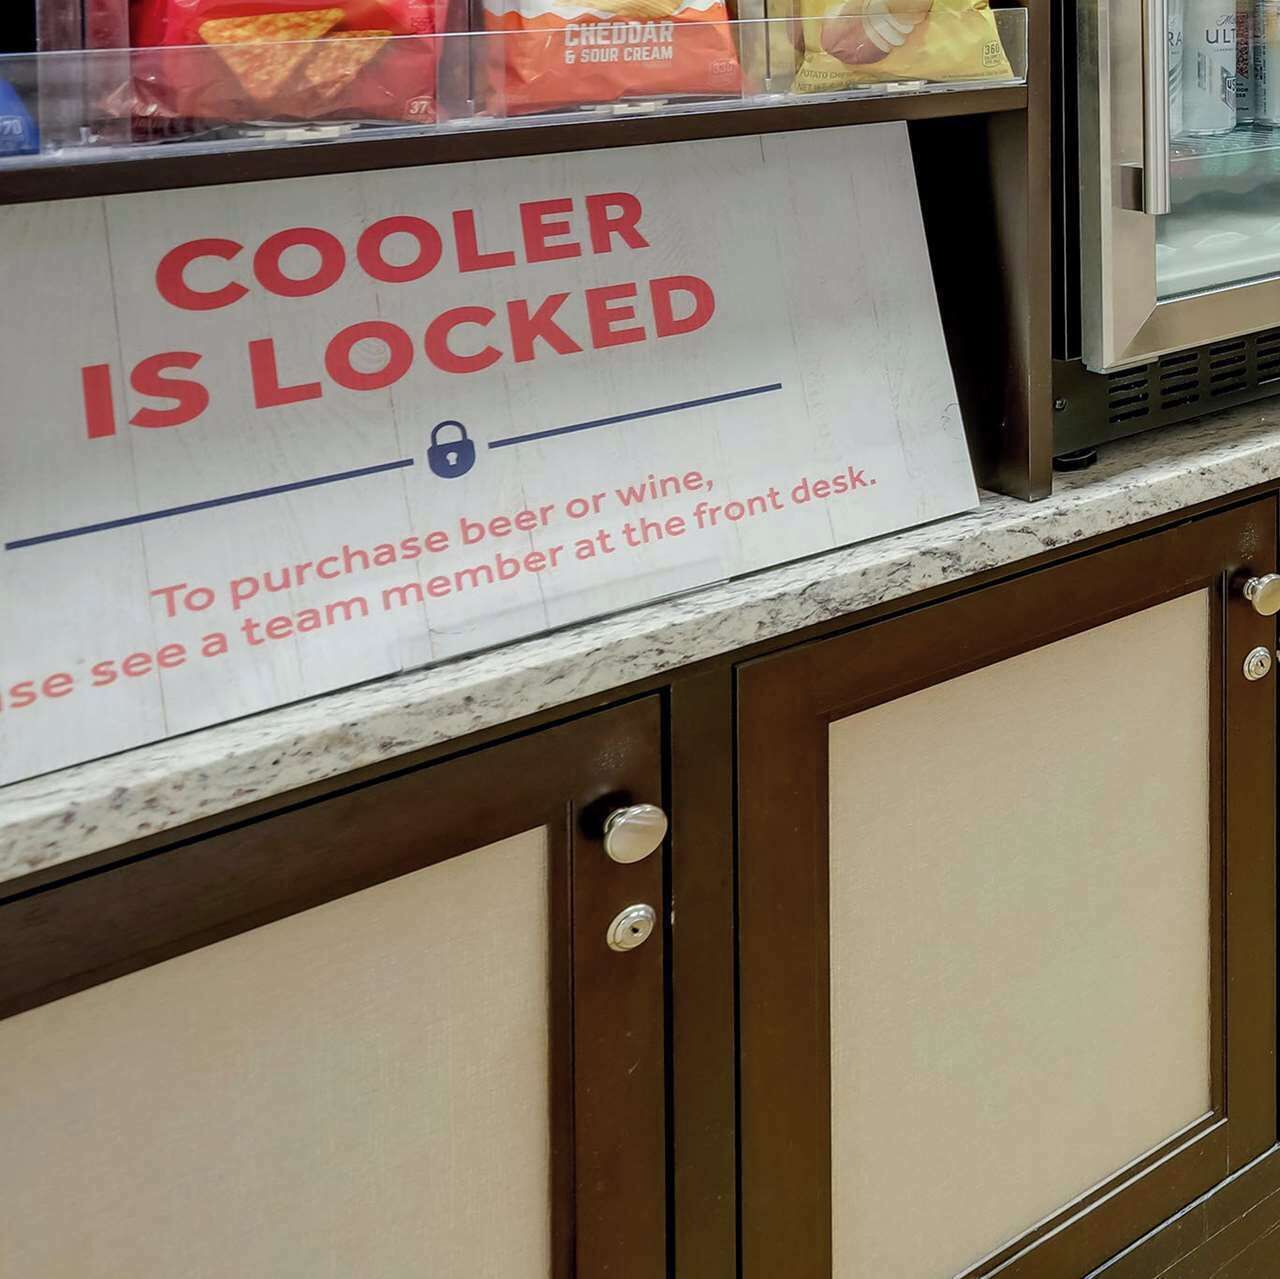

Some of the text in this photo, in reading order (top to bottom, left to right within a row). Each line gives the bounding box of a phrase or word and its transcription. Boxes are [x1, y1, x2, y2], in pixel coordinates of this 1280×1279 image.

[563, 21, 674, 48] CHEDDAR
[564, 44, 674, 66] & SOUR CREAM
[984, 44, 1002, 56] 360
[155, 191, 651, 312] COOLER
[81, 274, 717, 439] IS LOCKED
[90, 644, 190, 688] see
[199, 631, 230, 659] a
[239, 597, 370, 649] team
[388, 544, 566, 609] member
[574, 529, 615, 560] at
[621, 513, 688, 550] the
[692, 484, 782, 531] front
[789, 464, 880, 507] desk.
[150, 466, 717, 619] To purchase beer or wine,
